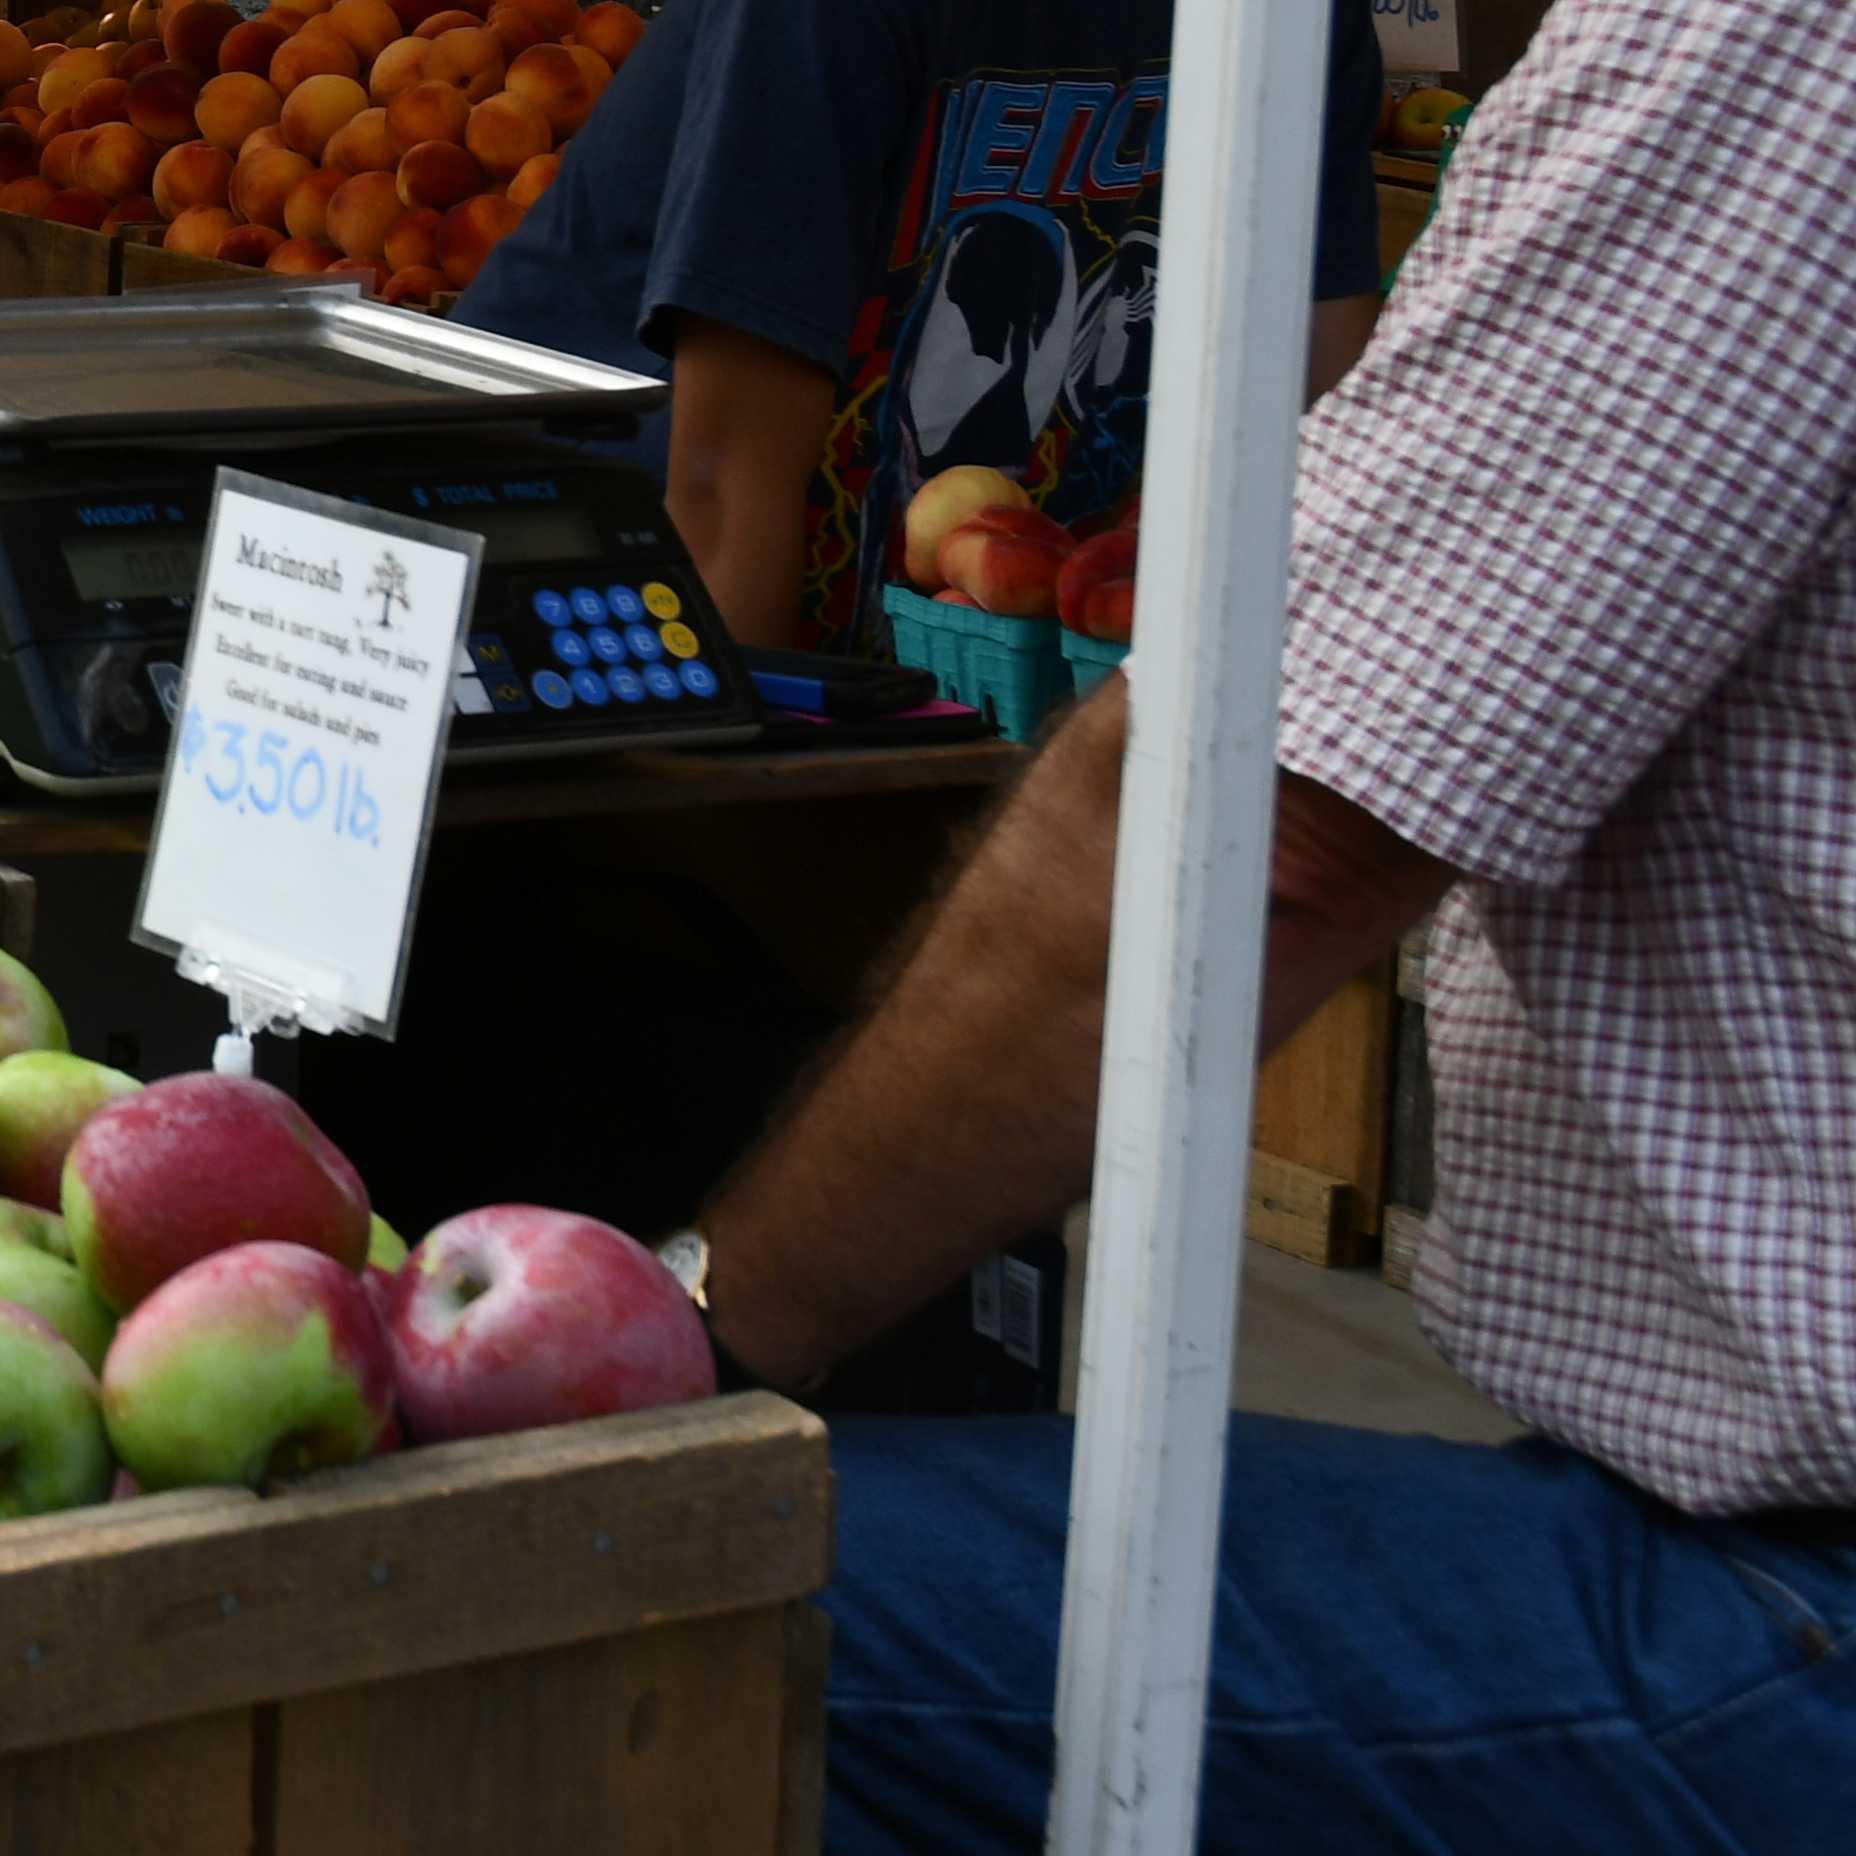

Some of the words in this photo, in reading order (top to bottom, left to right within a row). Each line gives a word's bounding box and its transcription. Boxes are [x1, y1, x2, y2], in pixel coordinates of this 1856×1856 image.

[438, 483, 497, 506] TOTAL
[503, 479, 562, 503] PRICE
[79, 503, 156, 527] WEIGHT
[360, 635, 390, 666] Very
[394, 651, 430, 678] juicy
[182, 702, 327, 823] $3.50
